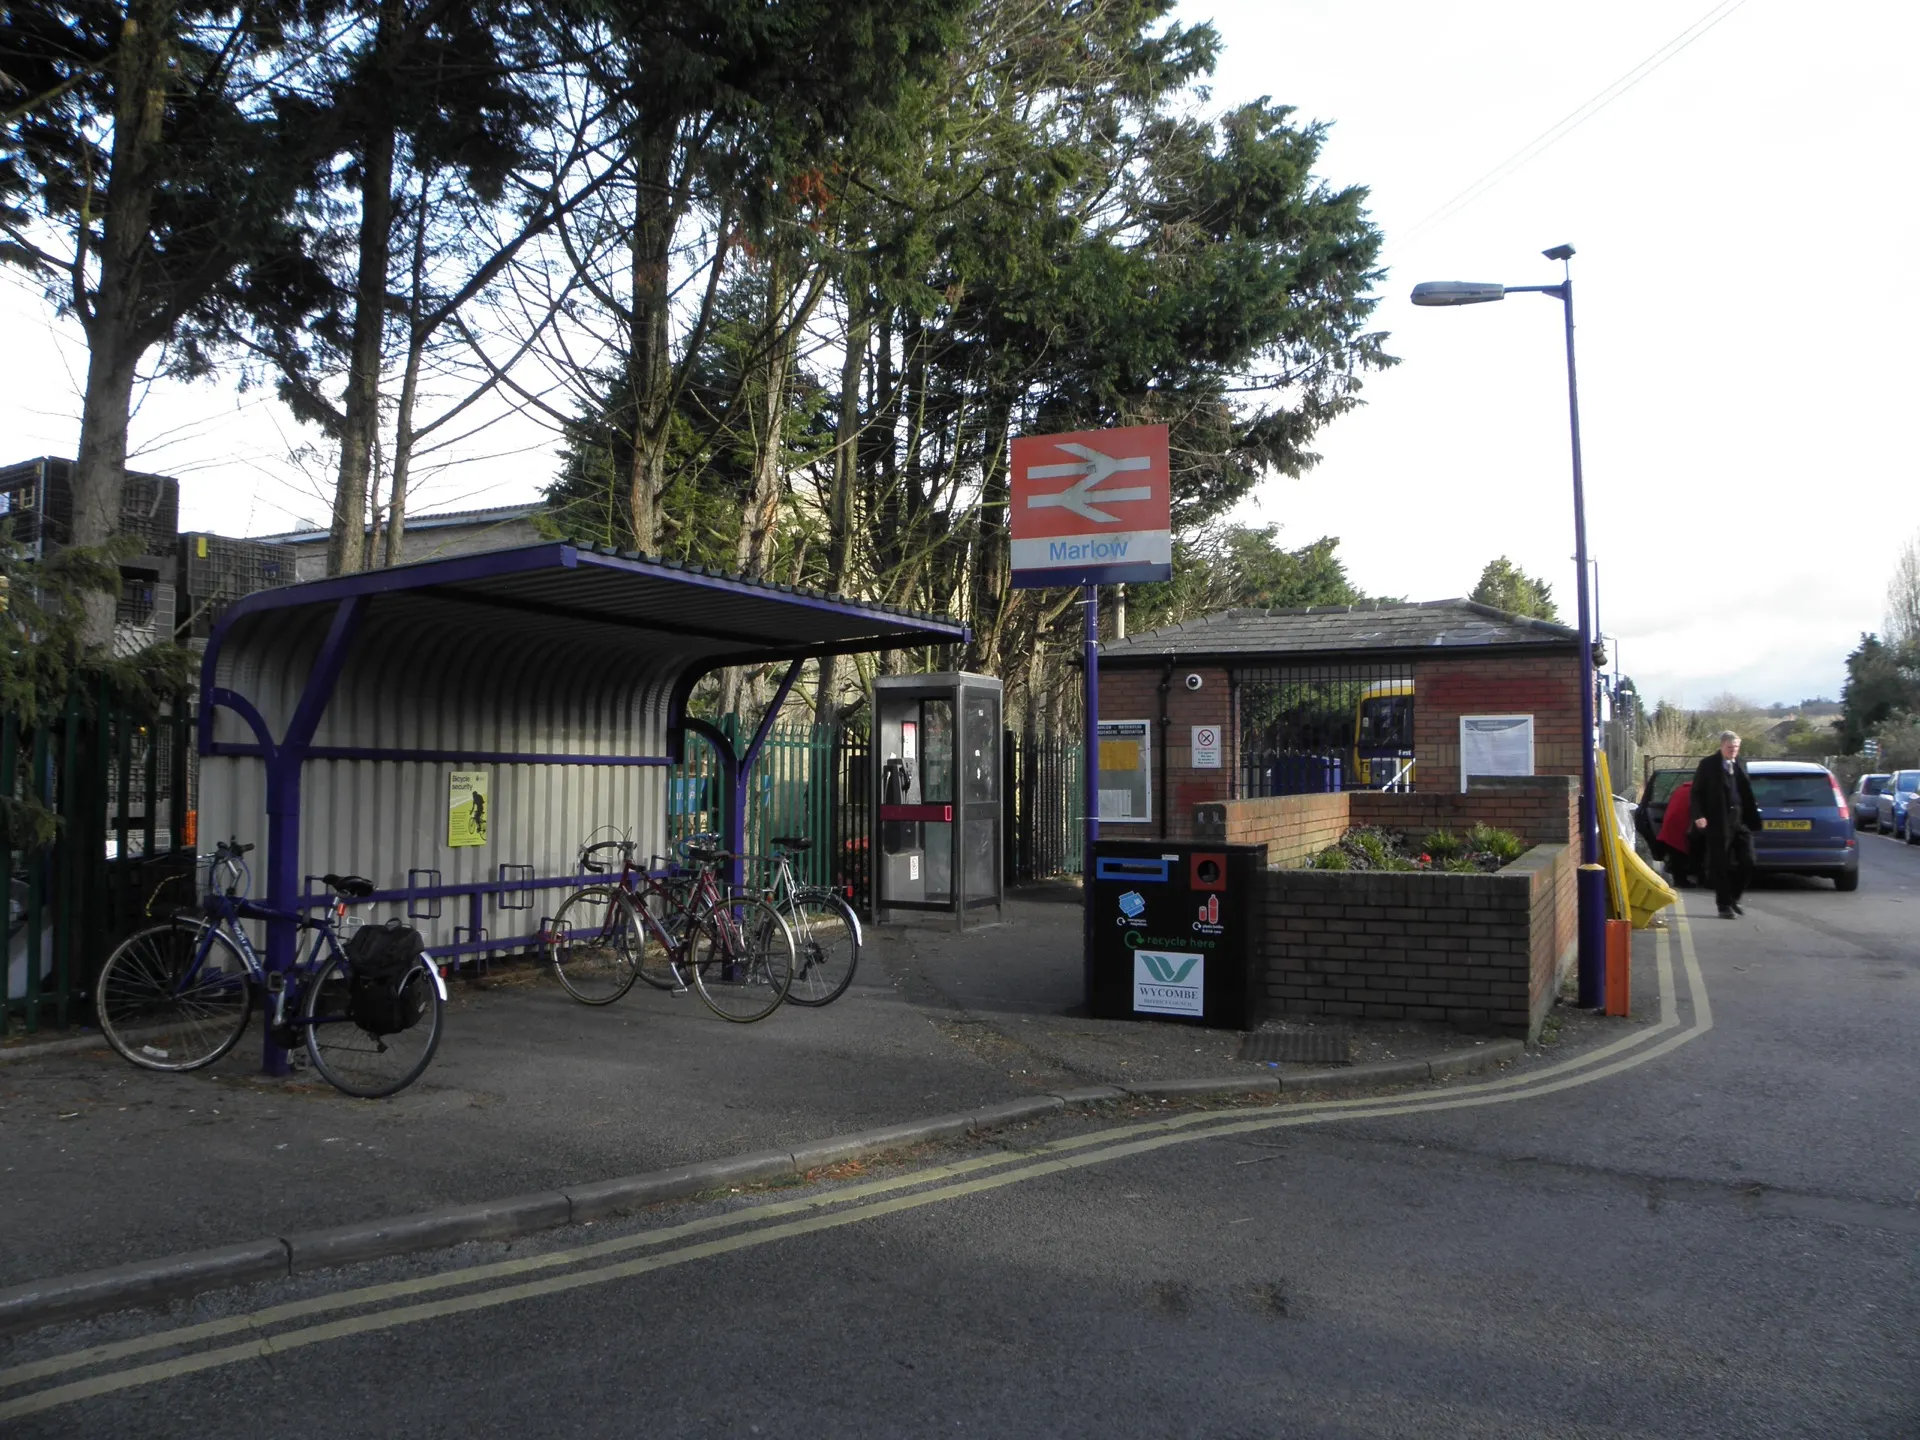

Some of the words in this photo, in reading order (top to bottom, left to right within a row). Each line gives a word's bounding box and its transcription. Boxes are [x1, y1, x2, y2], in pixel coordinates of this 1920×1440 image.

[1049, 540, 1128, 561] Marlow
[452, 775, 470, 783] Bicycle
[452, 783, 473, 791] security
[1147, 936, 1186, 948] recycle
[1190, 936, 1215, 948] here
[1140, 987, 1198, 999] WYCOMBE
